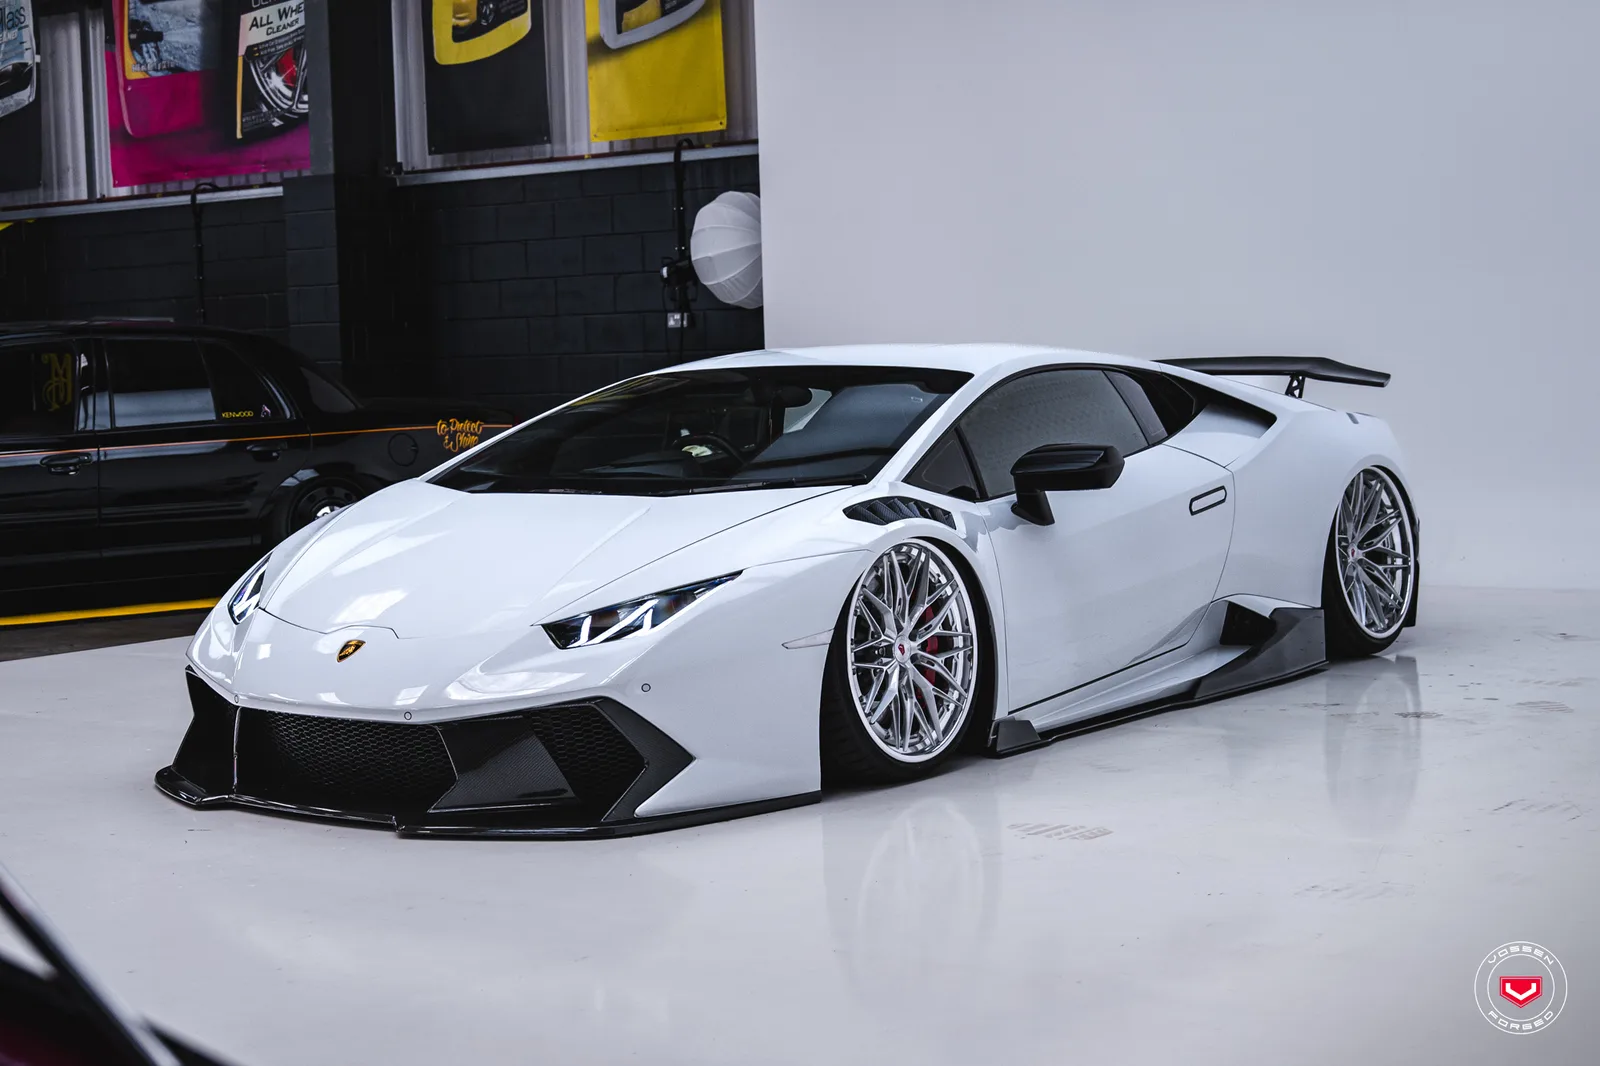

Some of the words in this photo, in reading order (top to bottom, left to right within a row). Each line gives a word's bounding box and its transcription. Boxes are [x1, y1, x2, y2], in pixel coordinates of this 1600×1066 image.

[249, 14, 273, 31] ALL
[266, 17, 300, 36] CLEANER
[221, 410, 254, 418] KENWOOD
